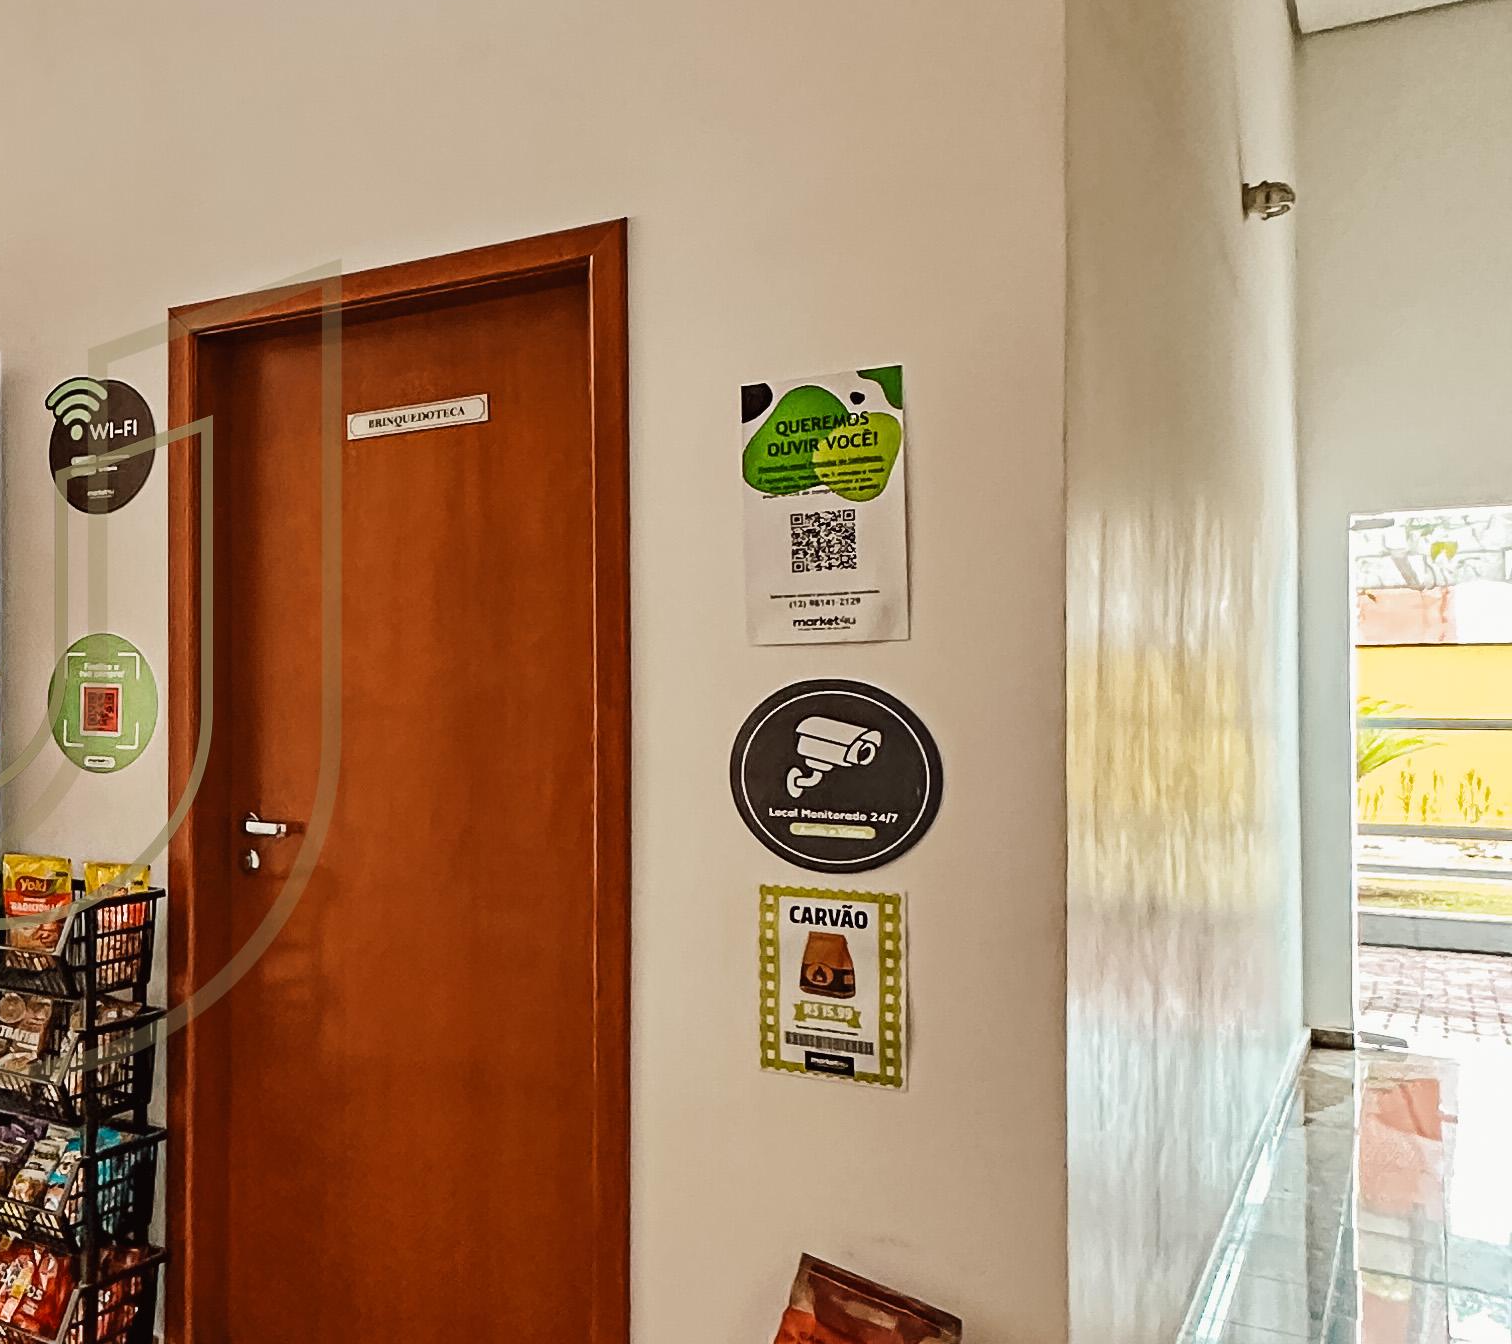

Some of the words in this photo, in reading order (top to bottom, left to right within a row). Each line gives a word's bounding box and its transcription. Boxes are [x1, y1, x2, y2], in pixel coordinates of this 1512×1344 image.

[368, 406, 465, 428] BRINQUEDOTECA
[775, 411, 870, 437] QUEREMOS
[89, 419, 138, 441] WI-FI
[767, 438, 820, 457] OUVIR
[825, 429, 878, 451] VOCÊ!
[792, 615, 856, 627] market4u
[768, 807, 798, 818] Local
[801, 808, 867, 821] Monitorado
[870, 812, 898, 824] 24/7
[789, 904, 868, 929] CARVÃO
